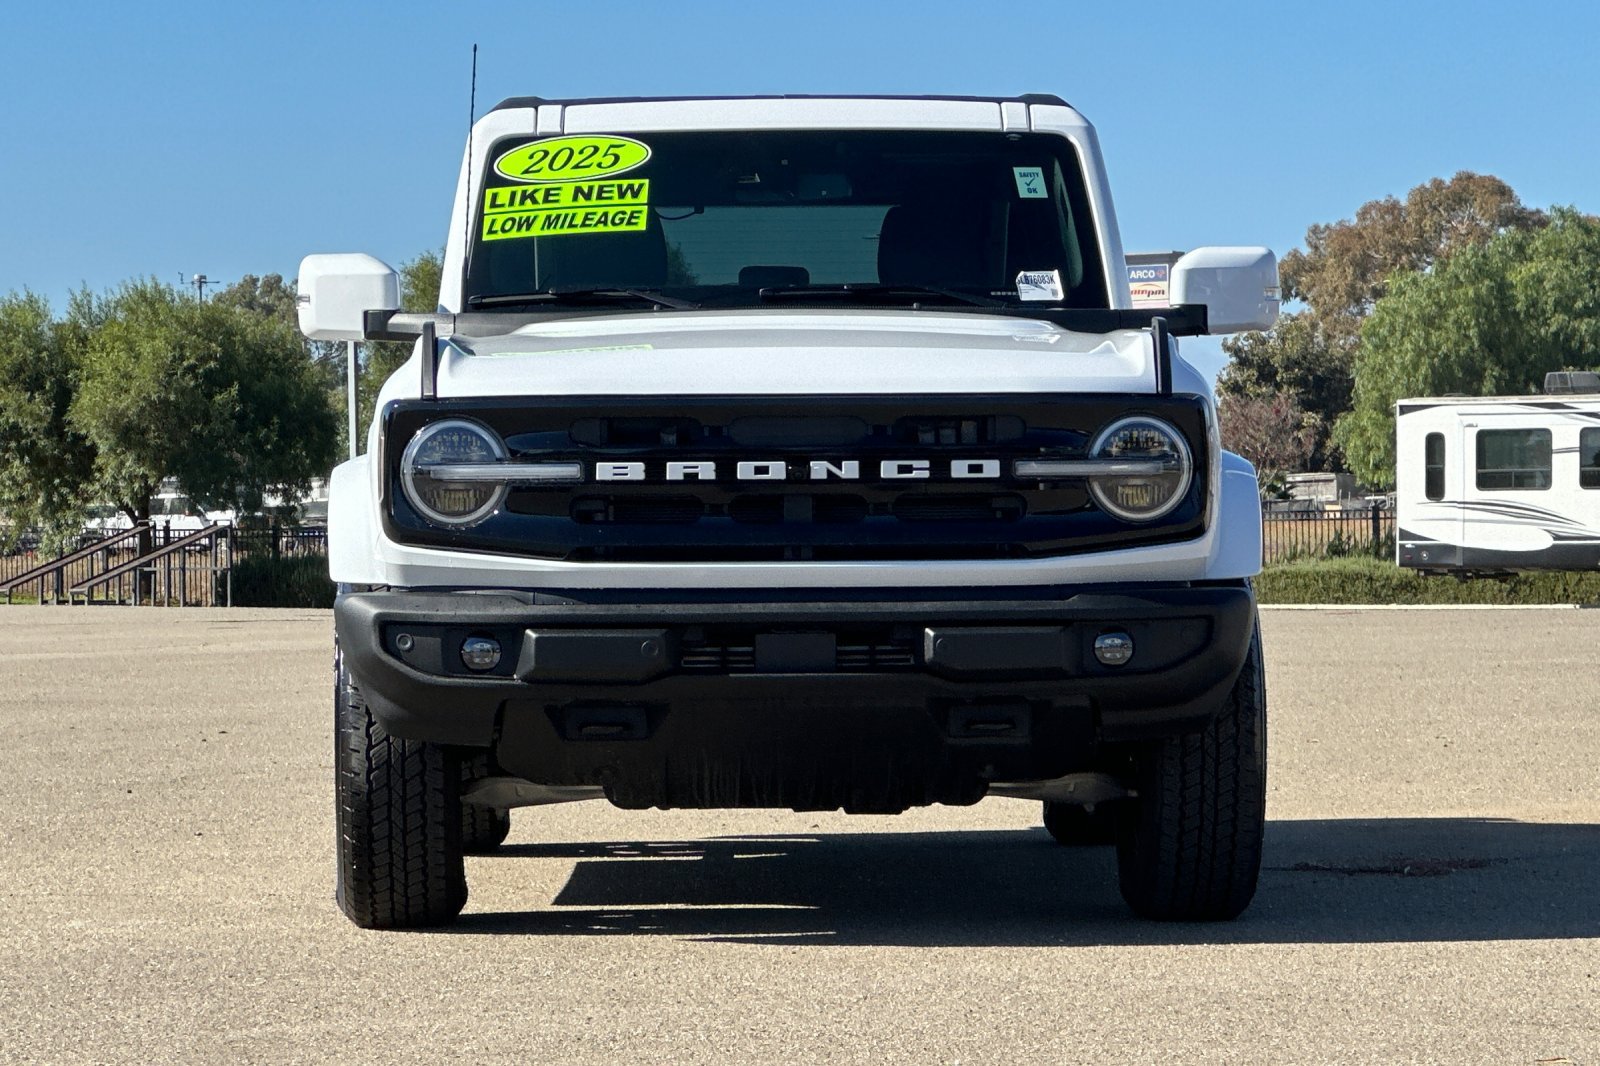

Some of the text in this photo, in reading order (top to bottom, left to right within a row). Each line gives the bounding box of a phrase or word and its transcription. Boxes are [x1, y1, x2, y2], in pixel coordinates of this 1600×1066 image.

[521, 144, 626, 175] 2025
[489, 183, 645, 208] LIKE NEW
[486, 210, 642, 236] LOW MILEAGE
[1129, 270, 1155, 279] ARCO
[596, 459, 1000, 481] BRONCO
